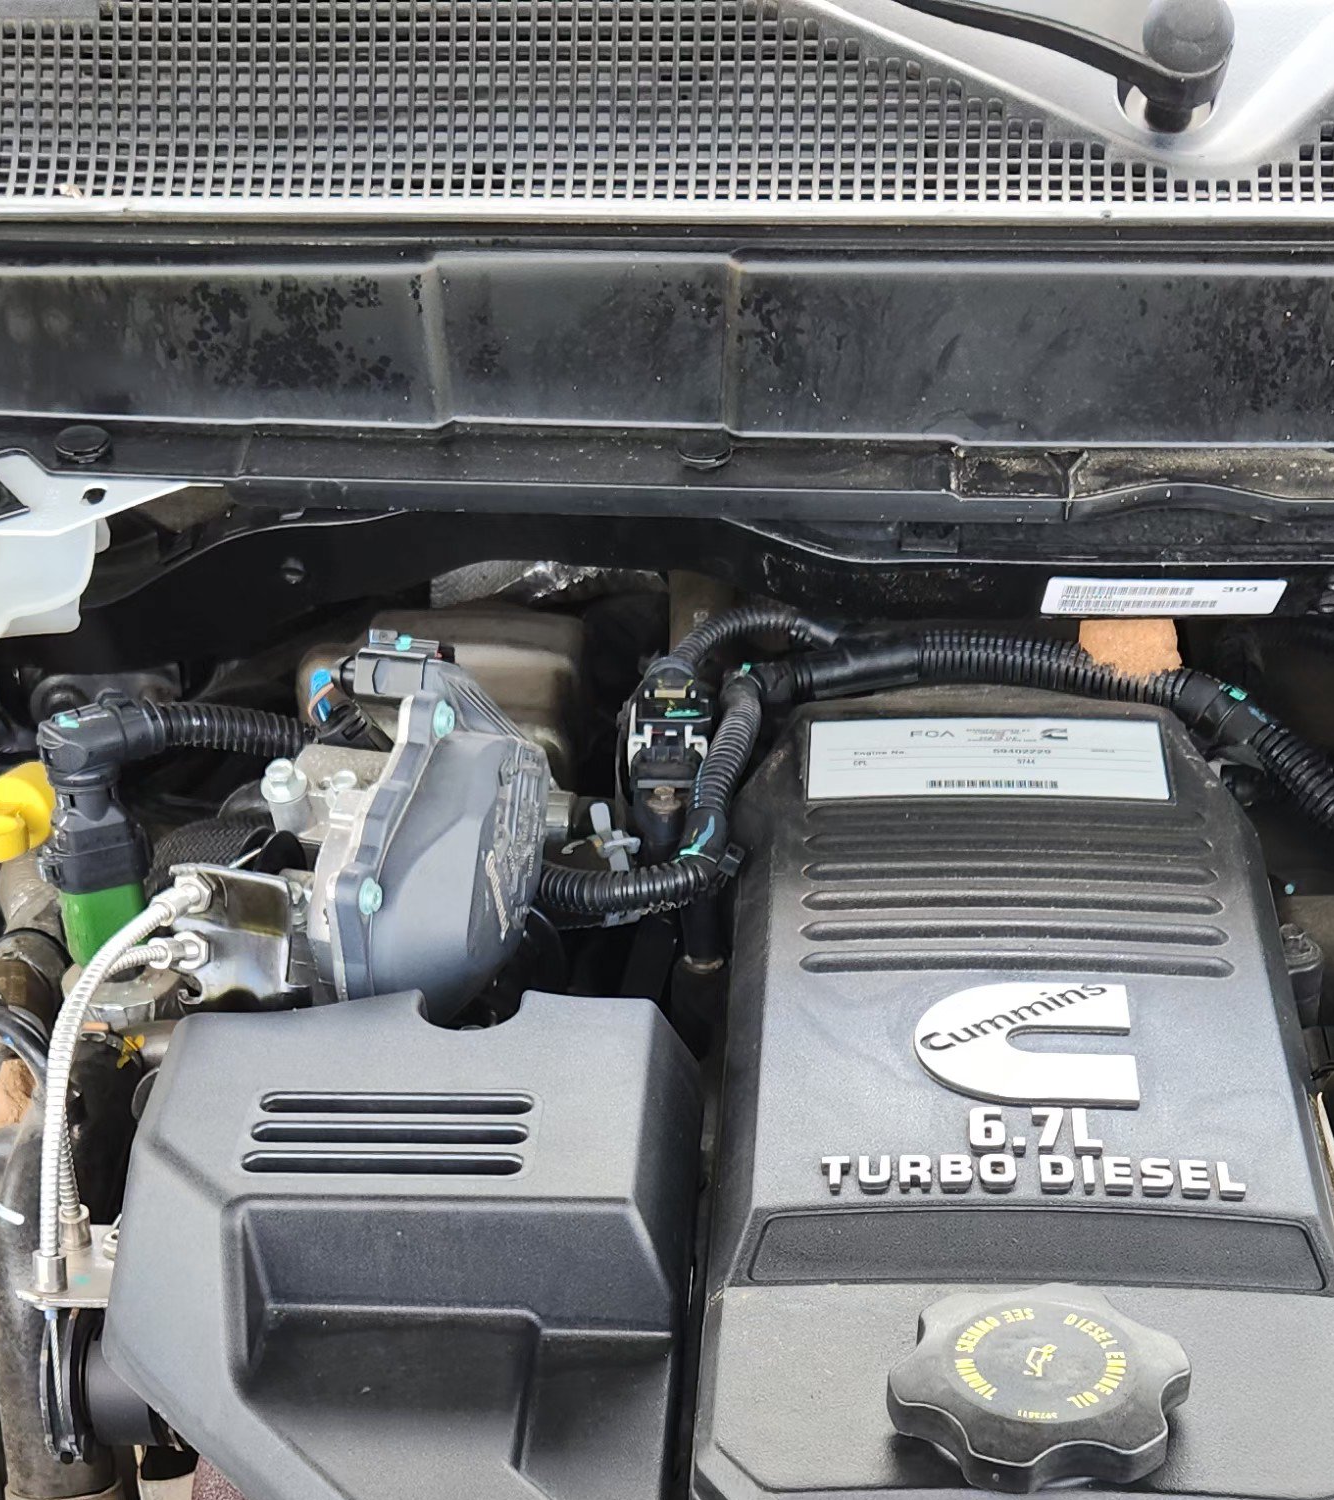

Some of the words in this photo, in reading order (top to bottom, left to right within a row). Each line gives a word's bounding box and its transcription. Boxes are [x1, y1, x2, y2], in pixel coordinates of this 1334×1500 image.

[909, 730, 955, 738] FCA
[918, 982, 1108, 1054] Cummins
[967, 1106, 1104, 1157] 6.7L
[820, 1153, 1018, 1196] TURBO
[1039, 1155, 1247, 1201] DIESEL
[1001, 1307, 1035, 1323] SEE
[1063, 1313, 1118, 1349] DIESEL
[955, 1358, 998, 1400] MANUAL
[1093, 1351, 1127, 1395] ENGINE
[1066, 1391, 1100, 1409] OIL
